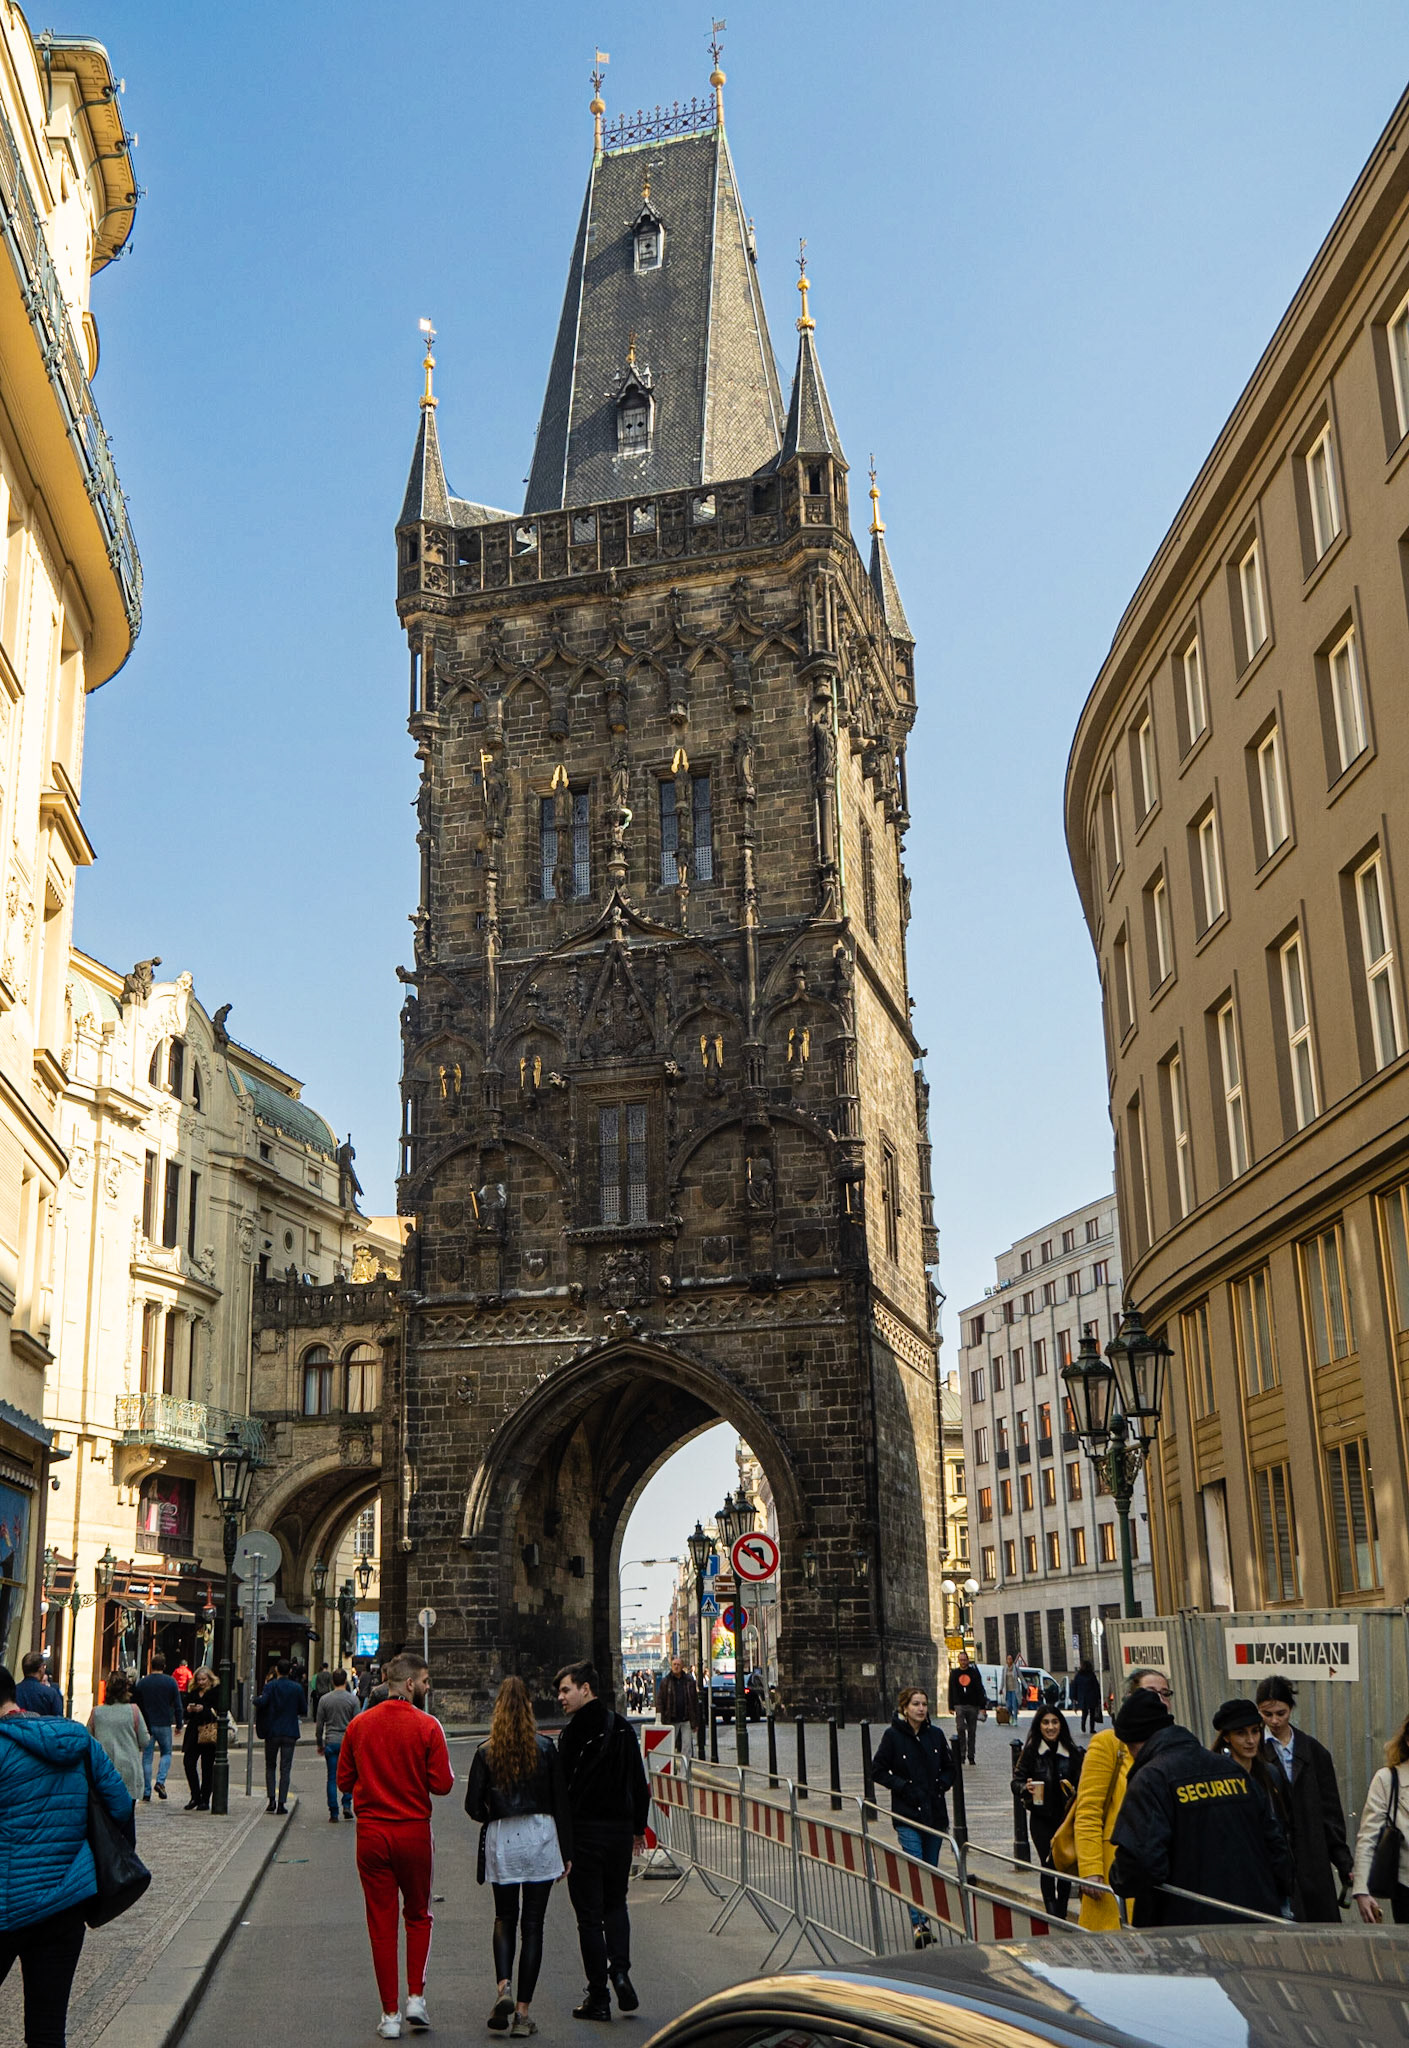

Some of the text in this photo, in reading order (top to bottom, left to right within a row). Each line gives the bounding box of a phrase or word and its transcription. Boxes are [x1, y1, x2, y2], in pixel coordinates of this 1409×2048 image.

[1130, 1646, 1163, 1665] LACHMAN
[1253, 1642, 1341, 1665] LACHMAN
[1176, 1778, 1248, 1803] SECURITY
